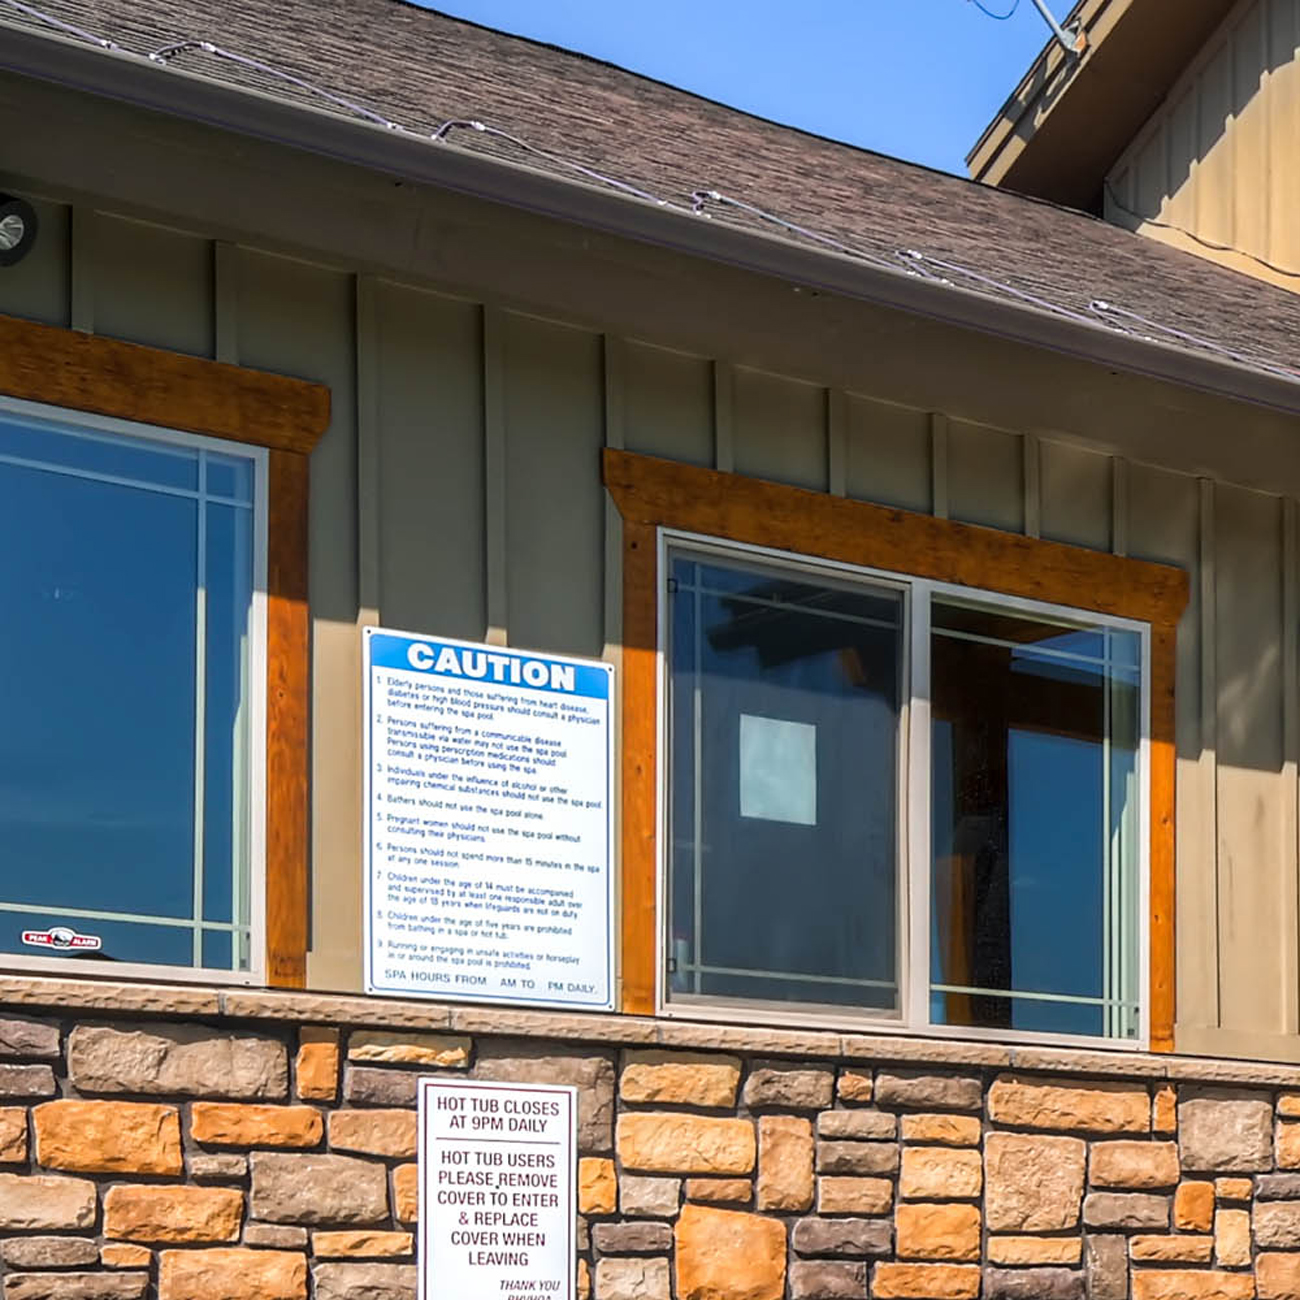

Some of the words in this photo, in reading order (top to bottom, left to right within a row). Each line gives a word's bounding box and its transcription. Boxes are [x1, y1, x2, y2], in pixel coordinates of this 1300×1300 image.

[407, 643, 575, 691] CAUTION
[384, 969, 406, 979] SPA
[410, 970, 451, 983] HOURS
[454, 973, 487, 985] FROM
[500, 977, 517, 988] AM
[520, 979, 536, 989] TO
[547, 980, 564, 991] PM
[437, 1096, 466, 1111] HOT
[470, 1097, 499, 1113] TUB
[503, 1099, 560, 1116] CLOSES
[449, 1114, 467, 1129] AT
[471, 1115, 503, 1131] 9PM
[508, 1117, 548, 1133] DAILY
[441, 1150, 470, 1165] HOT
[474, 1151, 503, 1166] TUB
[507, 1153, 555, 1168] USERS
[438, 1170, 493, 1185] PLEASE
[498, 1172, 558, 1187] REMOVE
[437, 1190, 485, 1206] COVER
[489, 1191, 508, 1206] TO
[512, 1192, 558, 1207] ENTER
[458, 1211, 469, 1225] &
[474, 1211, 538, 1227] REPLACE
[450, 1230, 499, 1246] COVER
[502, 1232, 545, 1247] WHEN
[468, 1251, 529, 1266] LEAVING
[499, 1279, 536, 1291] THANK
[539, 1279, 561, 1291] YOU
